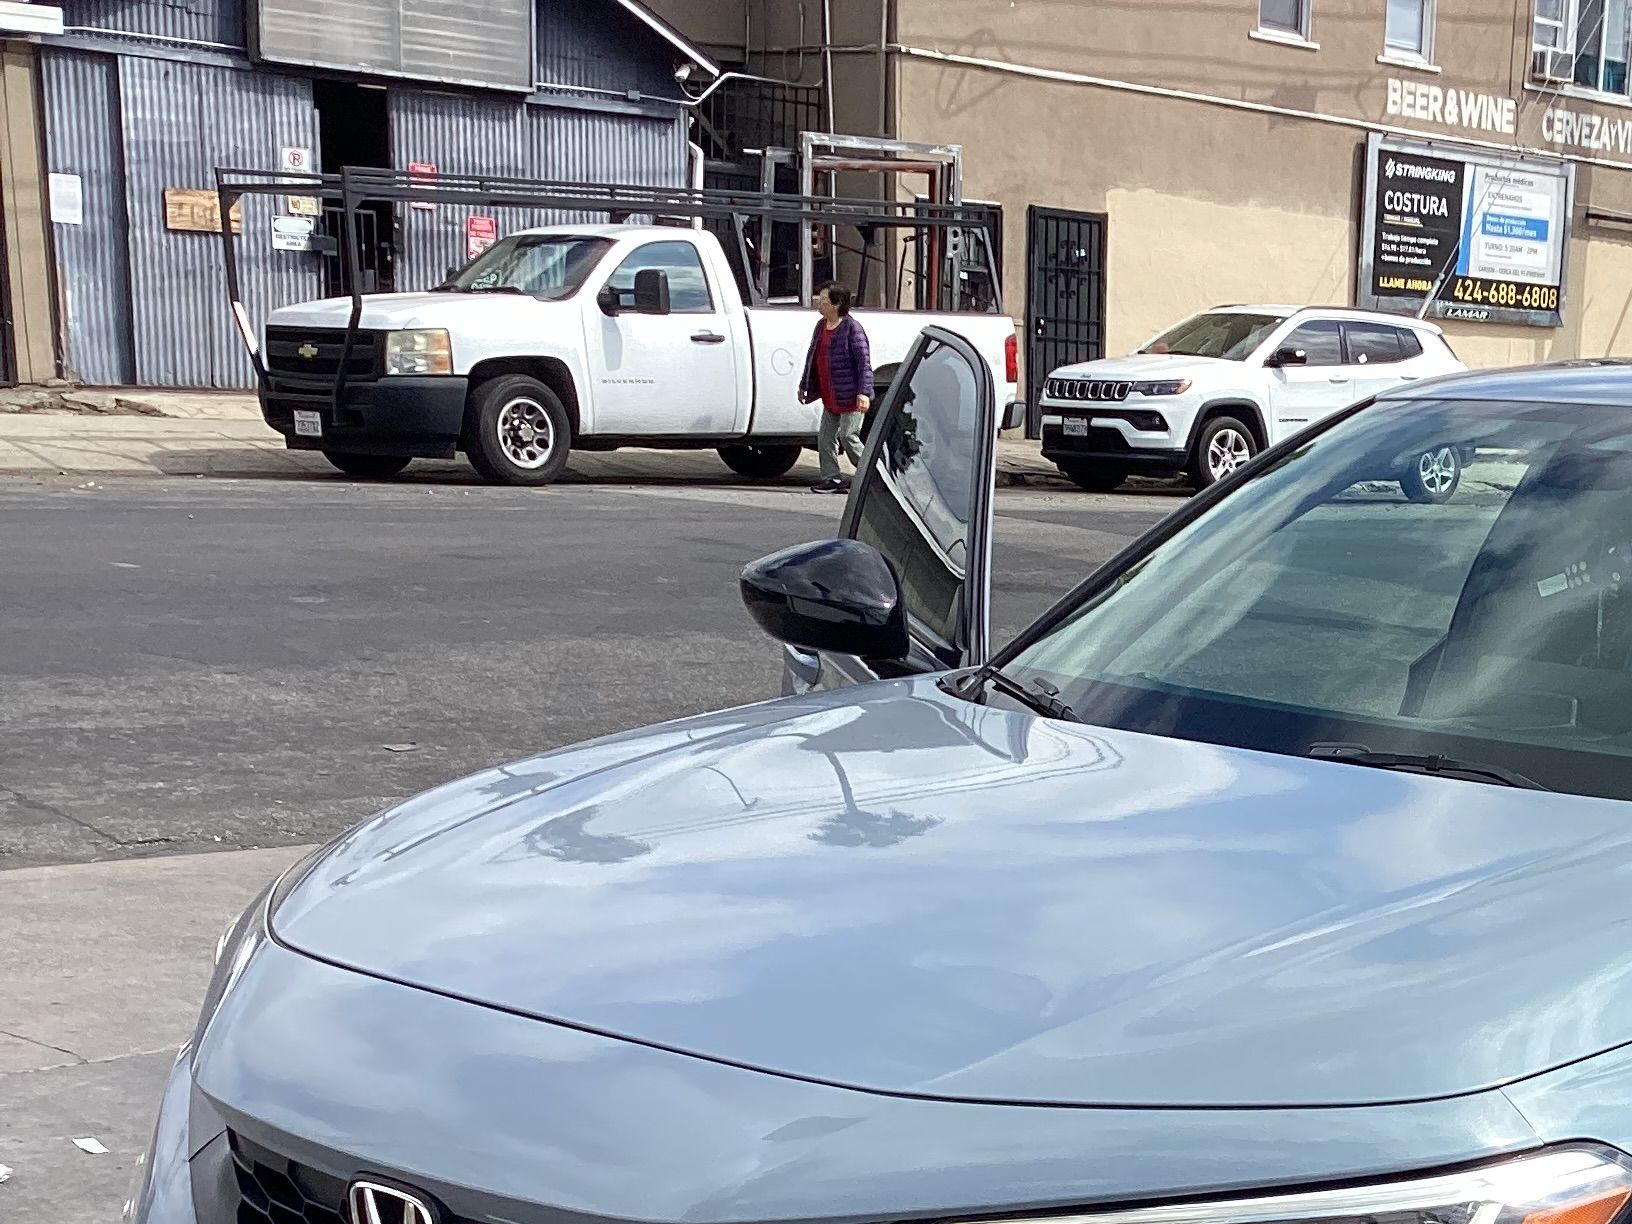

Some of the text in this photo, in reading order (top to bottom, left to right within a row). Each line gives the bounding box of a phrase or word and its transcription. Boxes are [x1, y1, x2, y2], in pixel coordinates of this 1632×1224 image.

[1395, 163, 1456, 184] STRINGKING
[1384, 190, 1449, 217] COSTURA
[1380, 276, 1432, 292] LLAME AHORA
[1454, 278, 1558, 309] 424-688-6808
[1447, 309, 1488, 319] LAMAR
